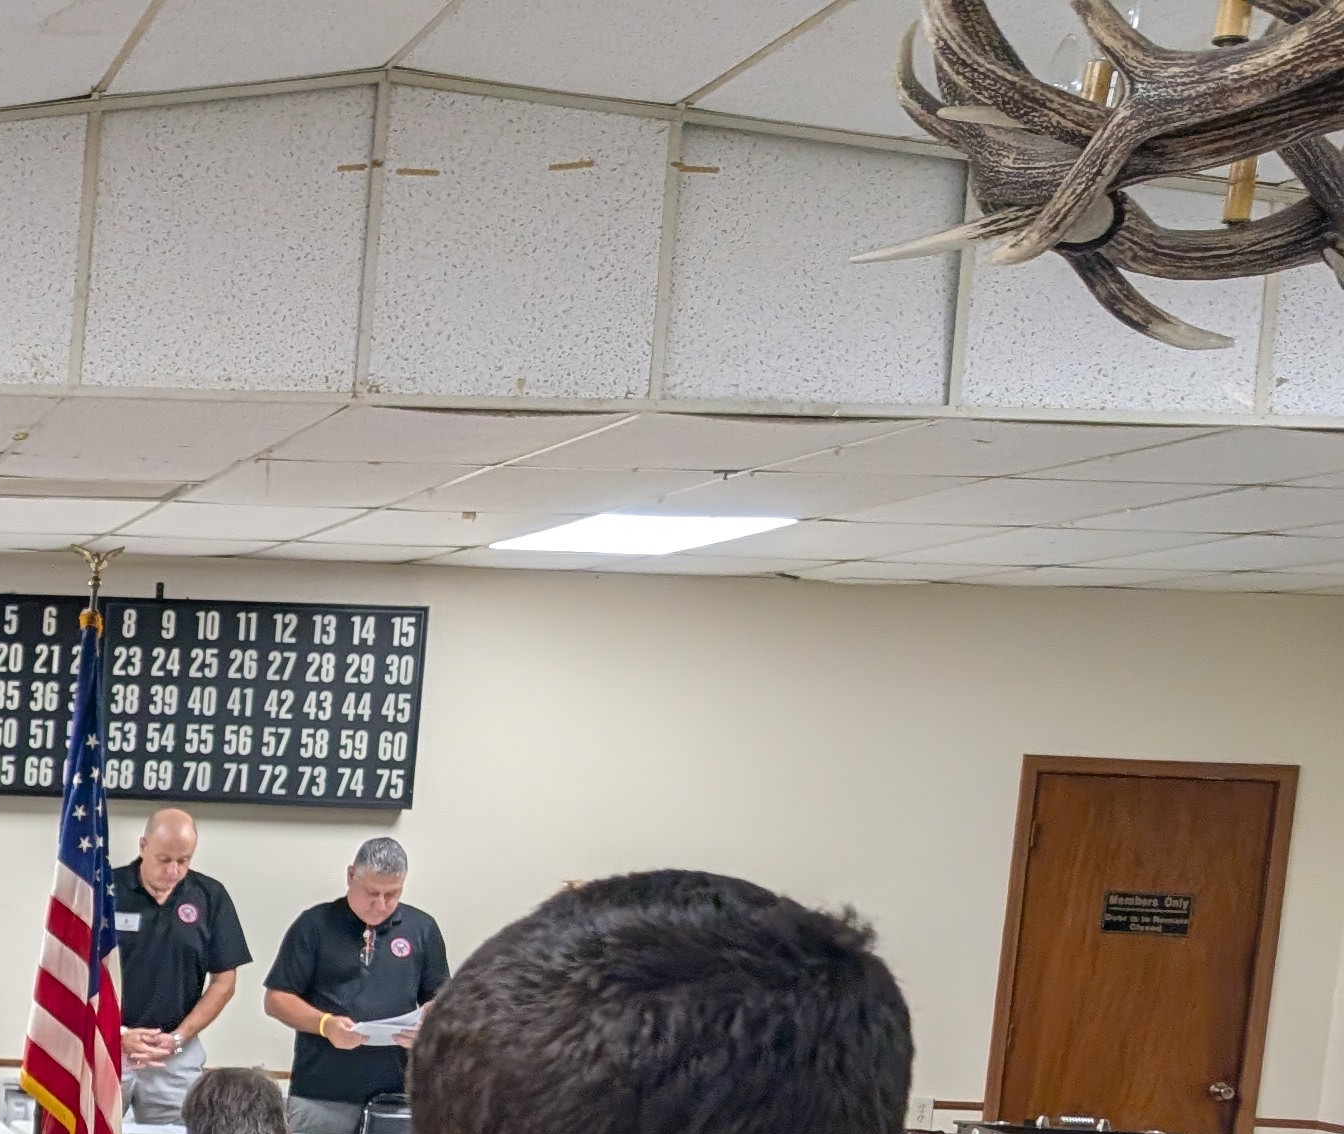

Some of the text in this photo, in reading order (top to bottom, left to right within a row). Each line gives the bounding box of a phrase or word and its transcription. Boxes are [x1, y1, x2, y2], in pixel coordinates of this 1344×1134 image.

[3, 605, 19, 635] 5
[42, 606, 57, 636] 6
[121, 608, 137, 639] 8
[161, 609, 176, 640] 9
[196, 610, 220, 641] 10
[236, 612, 258, 642] 11
[273, 613, 298, 644] 12
[312, 614, 337, 646] 13
[350, 615, 376, 646] 14
[390, 616, 417, 648] 15
[32, 643, 60, 675] 21
[70, 645, 83, 675] 2
[112, 646, 142, 677] 23
[150, 647, 181, 677] 24
[188, 648, 219, 679] 25
[227, 648, 258, 680] 26
[266, 650, 298, 681] 27
[304, 651, 337, 684] 28
[344, 652, 376, 685] 29
[384, 653, 415, 686] 30
[29, 680, 60, 712] 36
[68, 683, 79, 713] 3
[110, 683, 140, 715] 38
[148, 684, 179, 716] 39
[187, 685, 218, 717] 40
[226, 686, 255, 718] 41
[263, 688, 295, 720] 42
[302, 690, 334, 721] 43
[341, 691, 372, 722] 44
[380, 692, 412, 724] 45
[28, 718, 55, 750] 51
[107, 721, 138, 753] 53
[145, 722, 176, 753] 54
[184, 723, 215, 755] 55
[223, 724, 254, 756] 56
[261, 726, 292, 757] 57
[299, 727, 330, 760] 58
[338, 729, 369, 761] 59
[377, 730, 409, 762] 60
[23, 755, 55, 787] 66
[101, 758, 135, 790] 68
[143, 759, 174, 791] 69
[182, 760, 212, 792] 70
[222, 762, 249, 793] 71
[257, 764, 289, 795] 72
[296, 765, 328, 797] 73
[336, 767, 365, 798] 74
[375, 768, 405, 800] 75
[1109, 895, 1190, 910] Members Only
